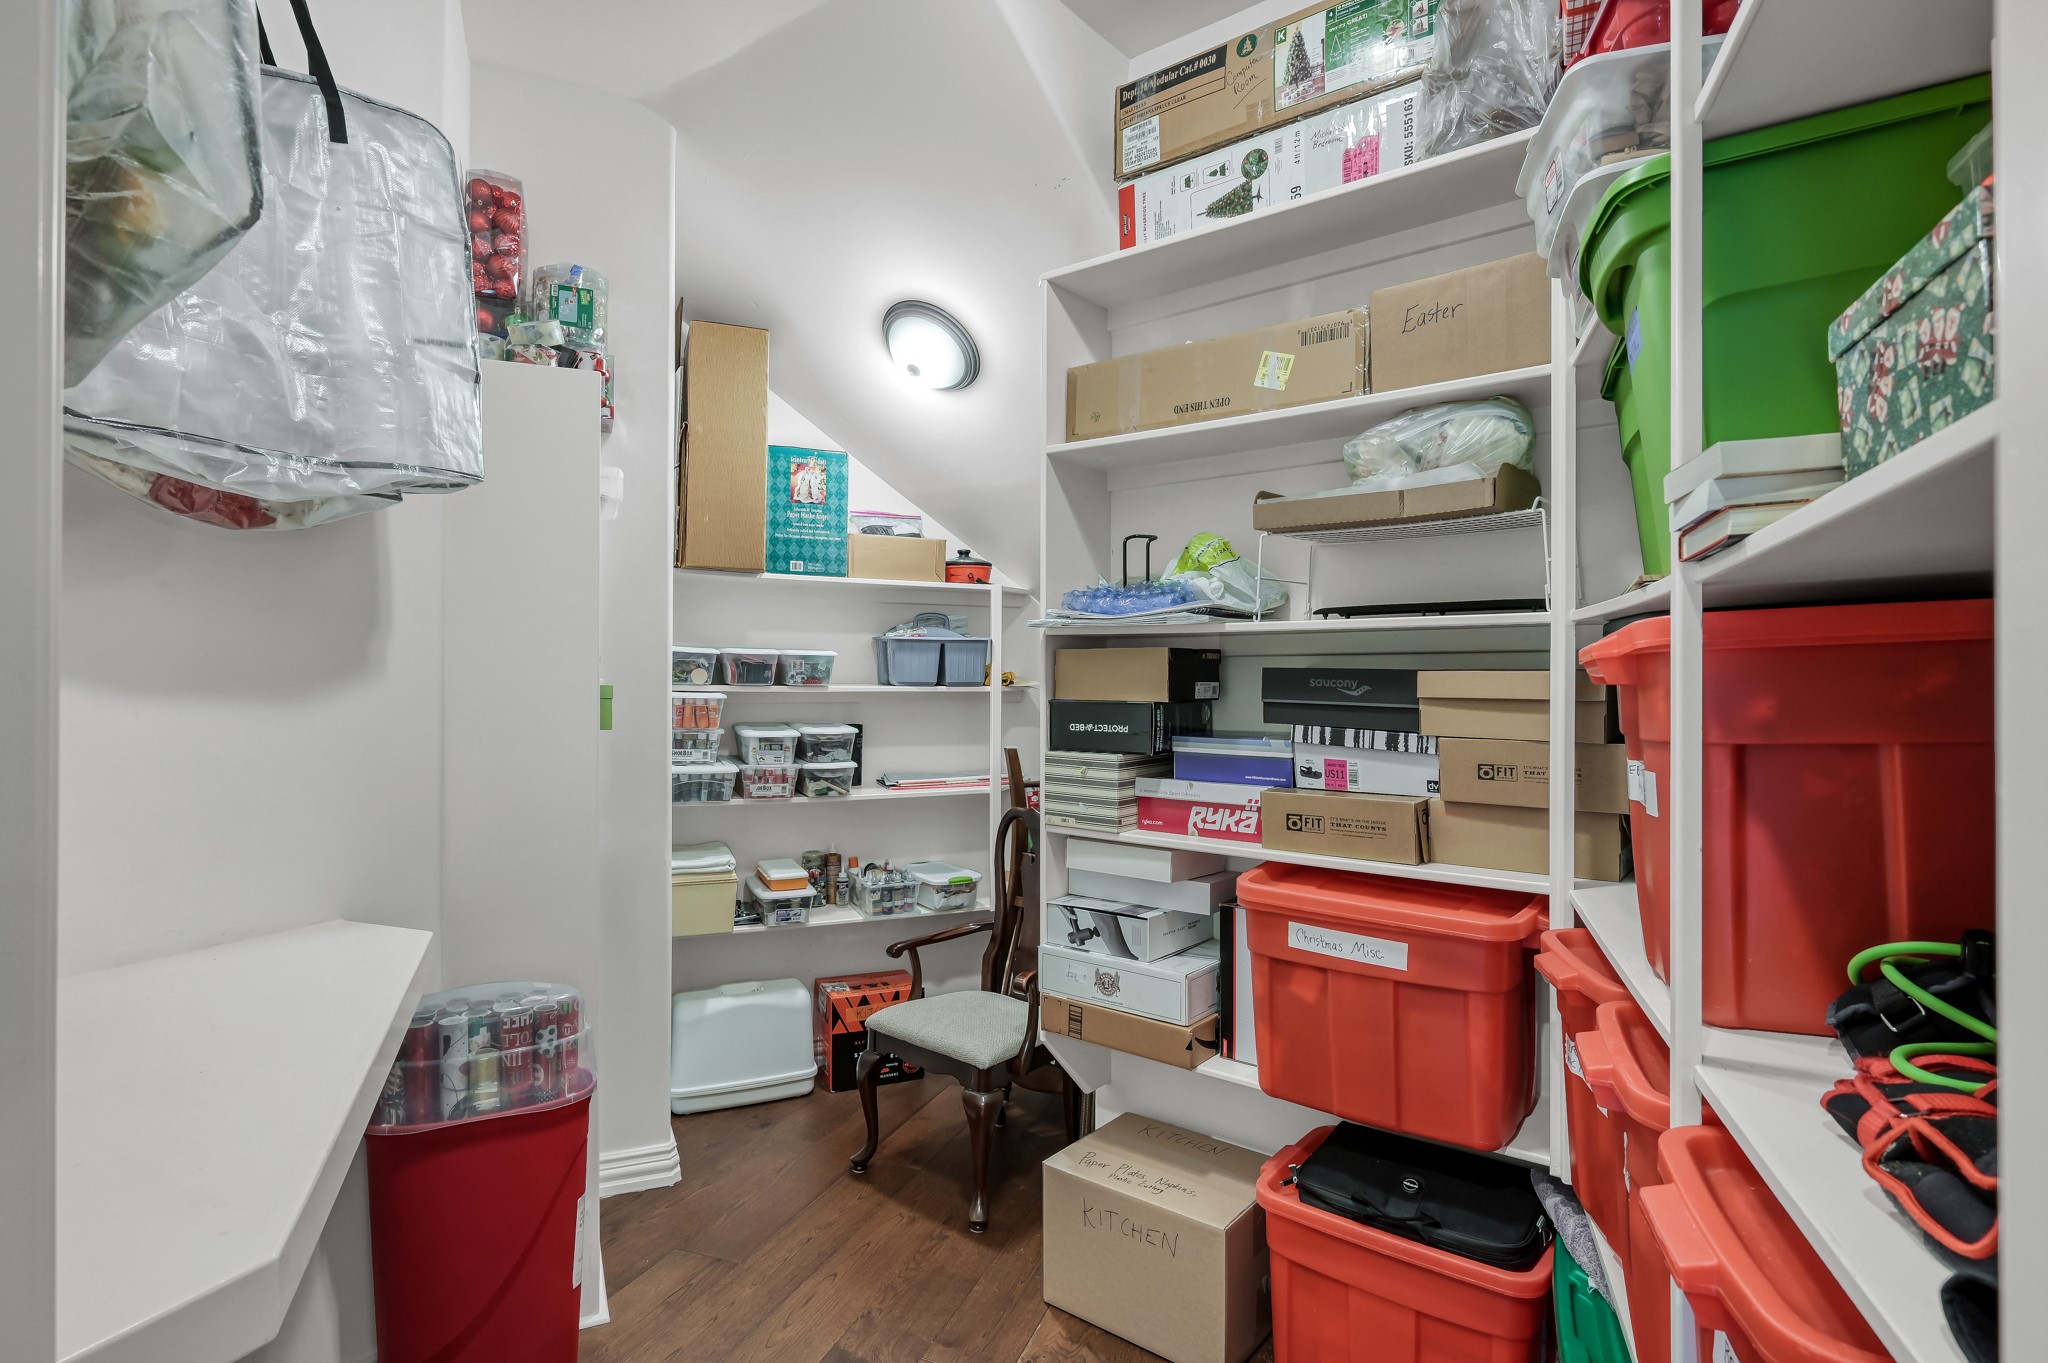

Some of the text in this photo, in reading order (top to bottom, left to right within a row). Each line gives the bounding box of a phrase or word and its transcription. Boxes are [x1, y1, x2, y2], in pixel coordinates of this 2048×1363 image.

[1276, 31, 1286, 42] K
[1122, 87, 1138, 102] Dept.
[1199, 53, 1217, 69] 0030
[1226, 56, 1264, 86] Computer
[1233, 74, 1260, 95] Room
[1403, 97, 1414, 166] SKU: 555163
[1401, 301, 1464, 335] Easter
[1173, 396, 1231, 415] OPEN THIS END
[1309, 678, 1359, 690] saucony
[1325, 769, 1345, 779] US11
[1496, 767, 1516, 778] FIT
[1428, 782, 1439, 790] dv
[1304, 817, 1323, 829] FIT
[1355, 824, 1387, 832] COUNTS
[1295, 927, 1343, 953] Christmas
[1137, 1123, 1230, 1156] KITCHEN
[1078, 1151, 1111, 1170] Paper
[1107, 1172, 1132, 1185] Plastic
[1082, 1198, 1179, 1258] KITCHEN
